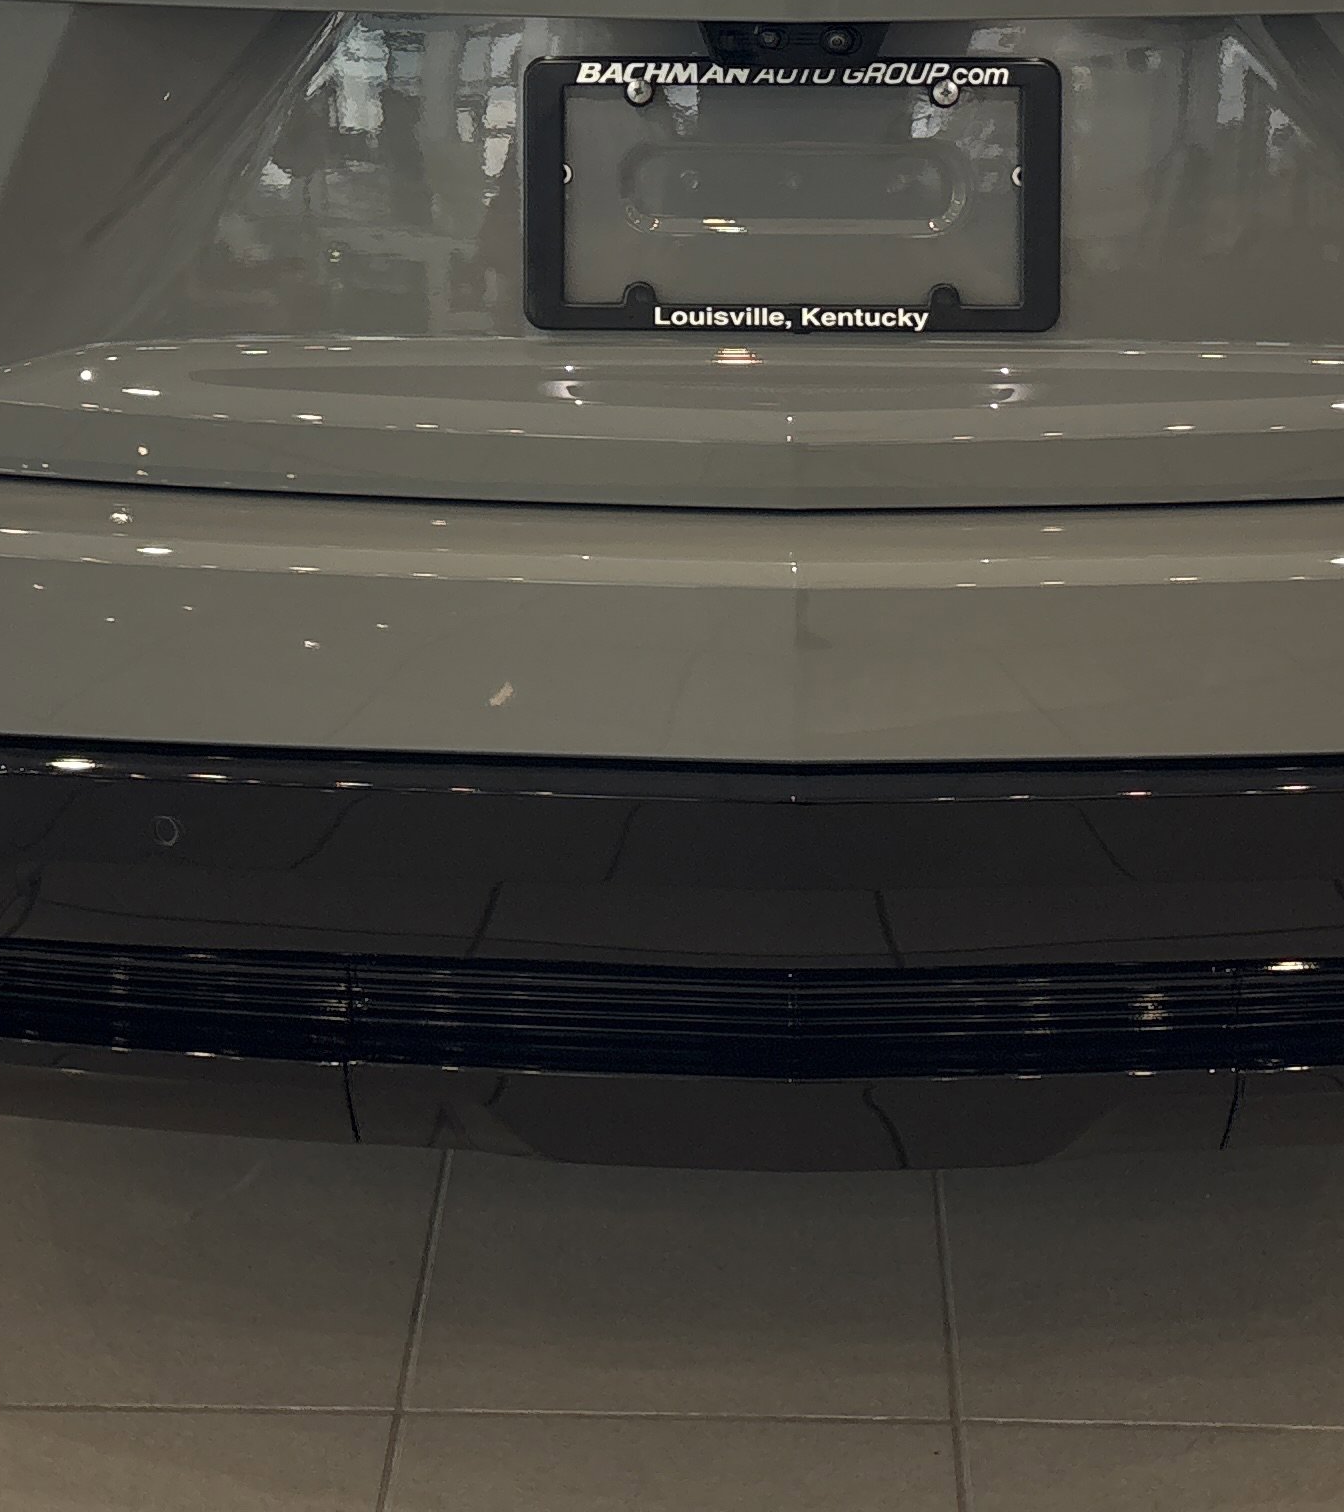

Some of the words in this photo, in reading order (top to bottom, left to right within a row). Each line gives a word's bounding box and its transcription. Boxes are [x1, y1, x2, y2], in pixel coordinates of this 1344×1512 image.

[575, 61, 751, 84] BACHMAN
[654, 306, 793, 329] Louisville,
[801, 307, 930, 332] Kentucky
